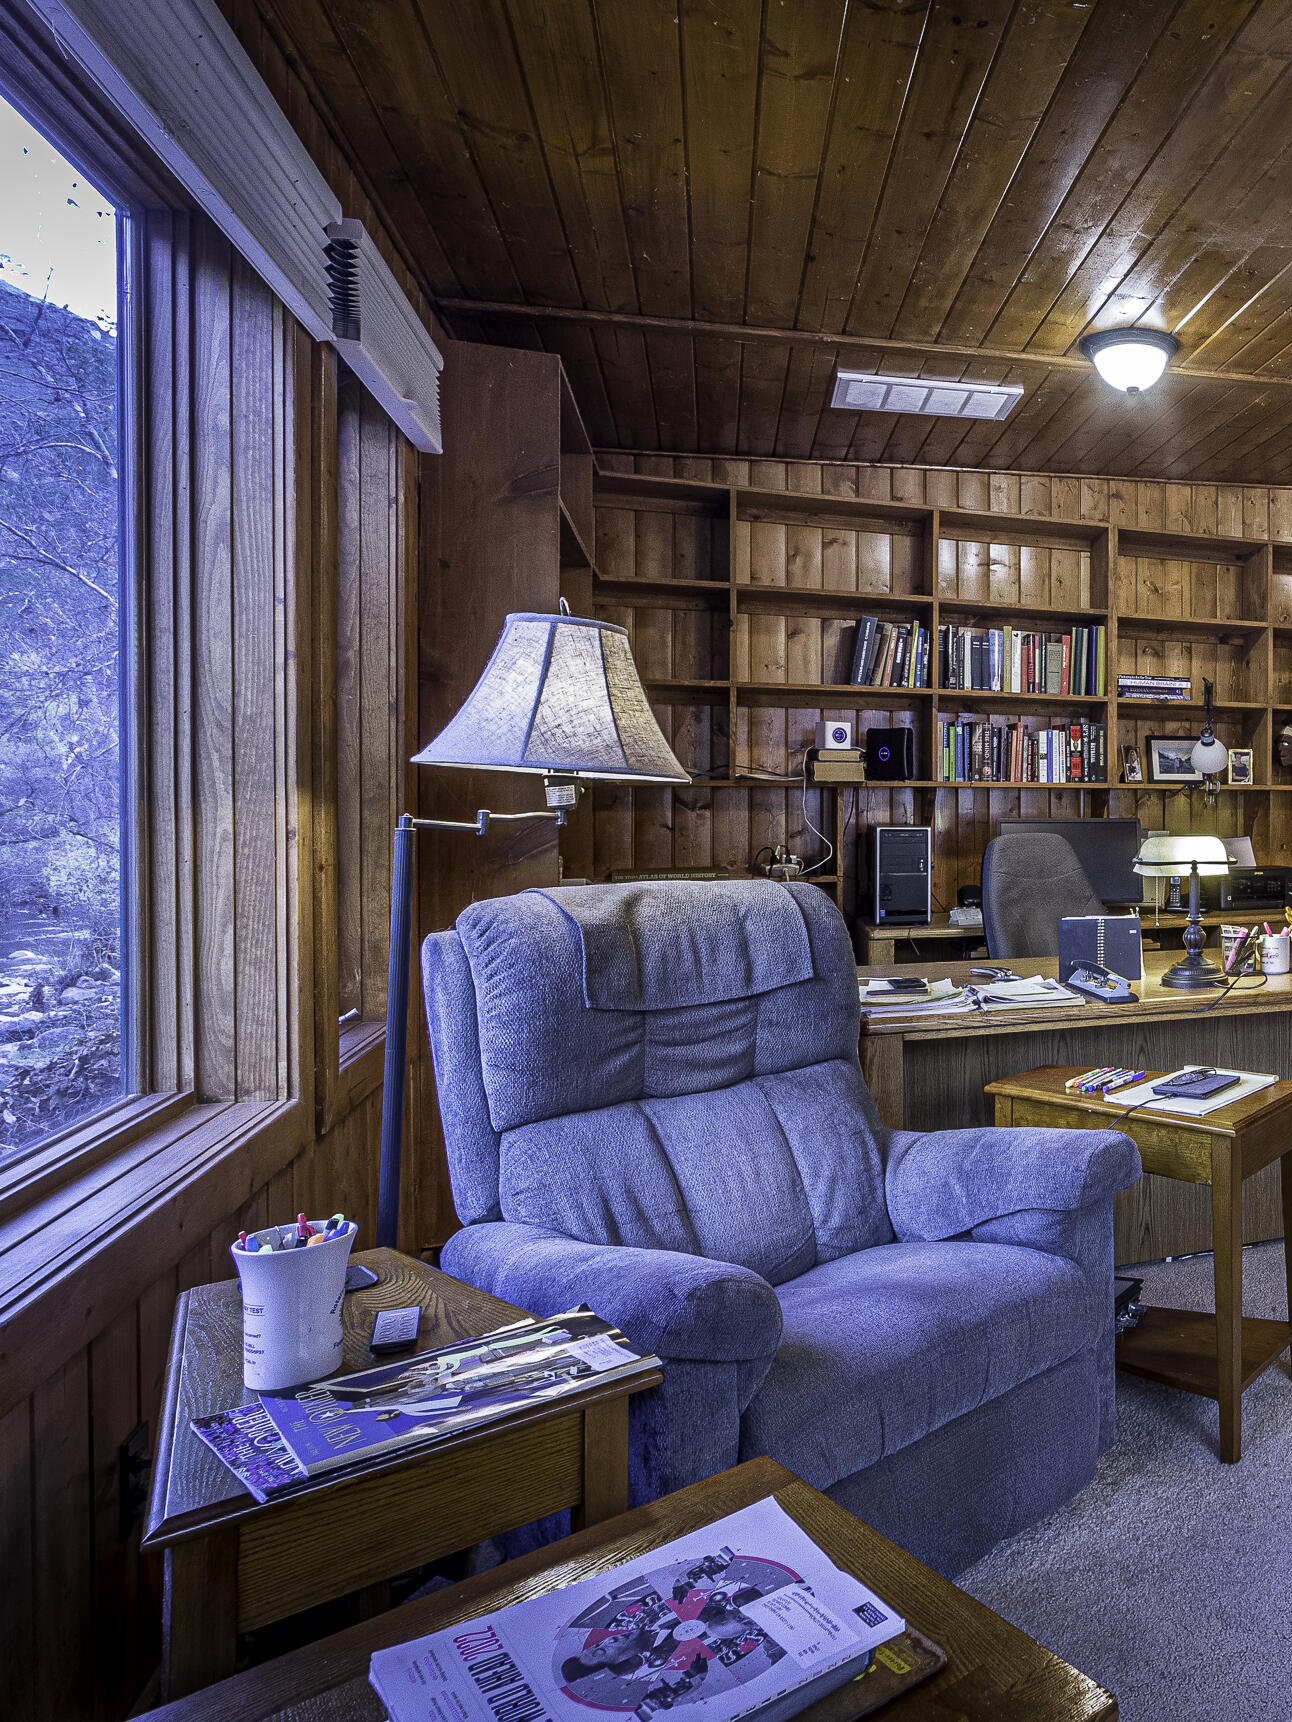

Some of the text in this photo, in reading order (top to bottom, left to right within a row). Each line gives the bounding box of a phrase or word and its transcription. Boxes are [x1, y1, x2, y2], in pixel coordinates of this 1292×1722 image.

[288, 1418, 308, 1433] THE
[295, 1388, 367, 1450] NEW YORKER
[232, 1440, 257, 1461] THE
[453, 1625, 504, 1661] 2022
[468, 1652, 524, 1694] AHEAD
